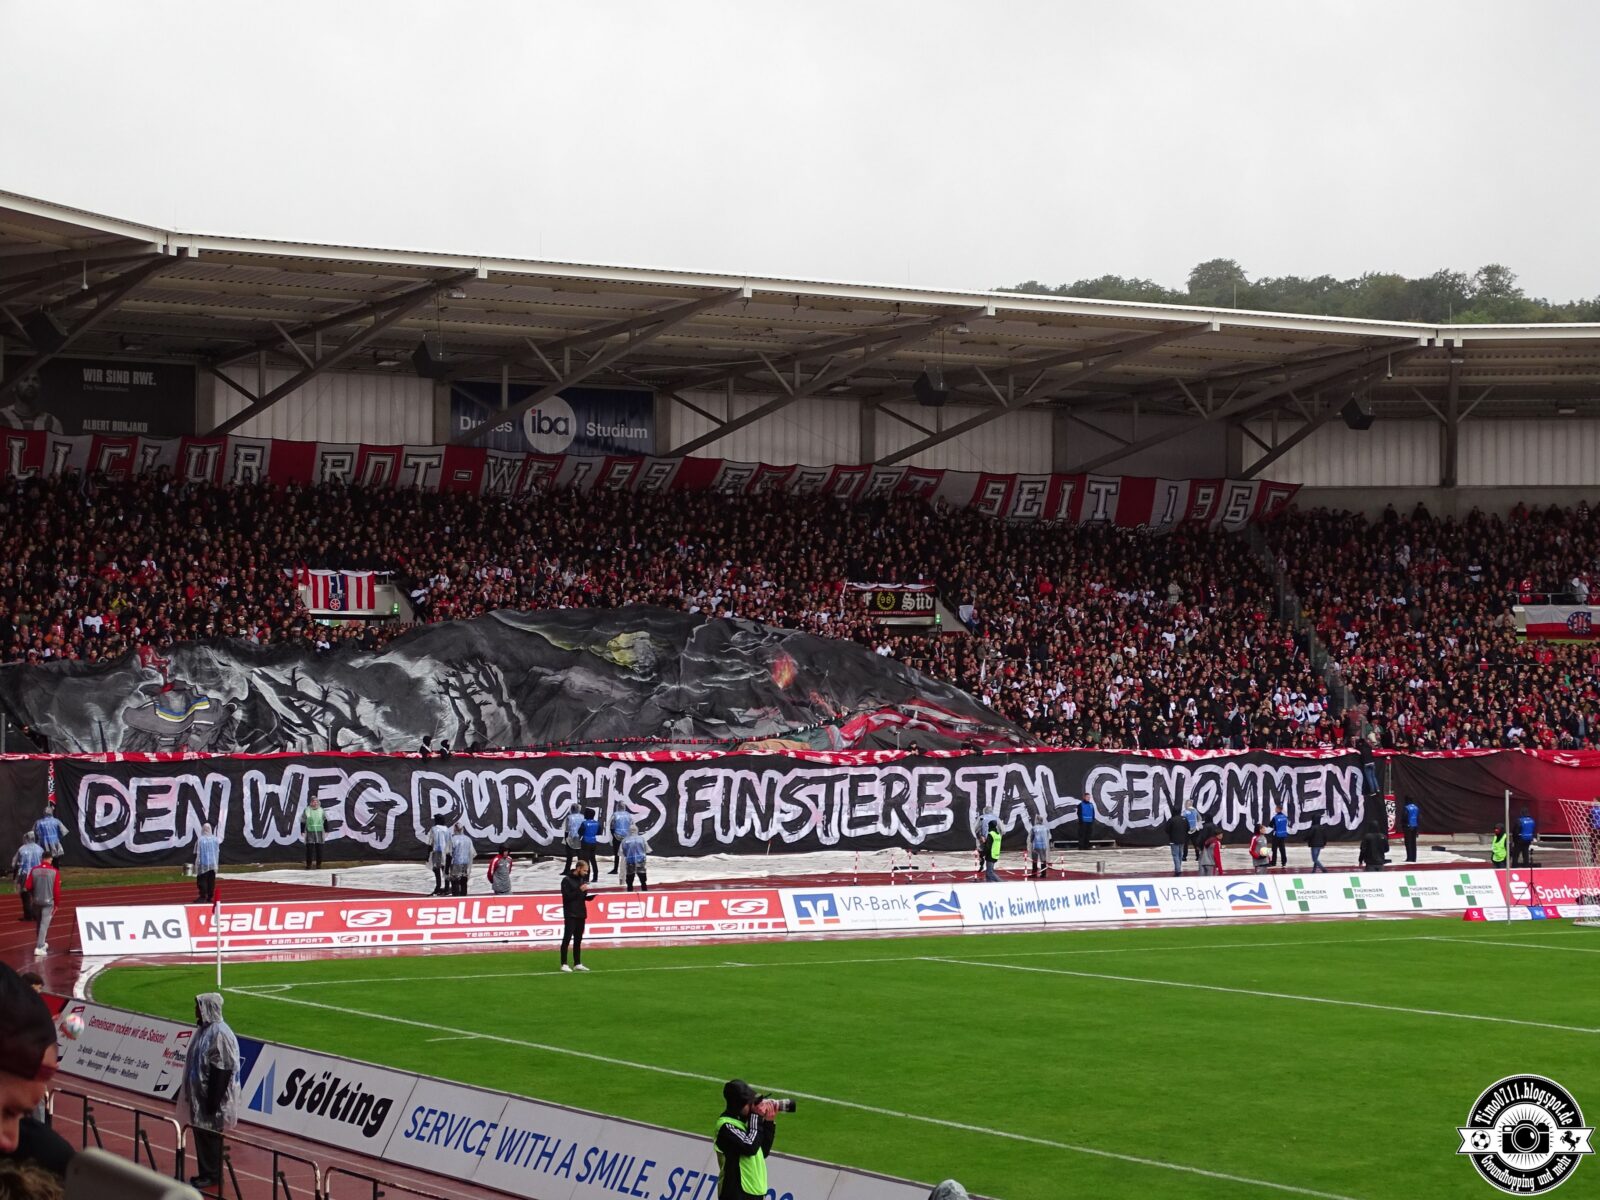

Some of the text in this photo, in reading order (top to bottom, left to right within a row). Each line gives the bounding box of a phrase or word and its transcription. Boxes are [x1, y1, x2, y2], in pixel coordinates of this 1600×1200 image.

[83, 368, 157, 386] WIR SIND RWE.
[83, 419, 110, 431] ALBERT
[531, 408, 569, 435] iba
[586, 422, 648, 438] Studium
[978, 480, 1118, 521] SEIT
[901, 592, 934, 611] Süd
[77, 772, 231, 852] DEN
[243, 764, 408, 850] WEG
[411, 761, 669, 846] DURCH'S
[677, 766, 954, 847] FINSTERE
[954, 762, 1079, 841] TAL
[1084, 762, 1365, 835] GENOMMEN
[840, 894, 911, 911] VR-Bank
[980, 885, 1101, 921] Wir kümmern uns!
[1160, 885, 1224, 901] VR-Bank
[1535, 884, 1600, 902] Sparkasse
[86, 919, 182, 941] NT.AG
[277, 1068, 394, 1138] Stölting
[404, 1105, 498, 1157] SERVICE
[495, 1126, 562, 1175] WITH
[555, 1143, 579, 1179] A
[575, 1146, 657, 1200] SMILE.
